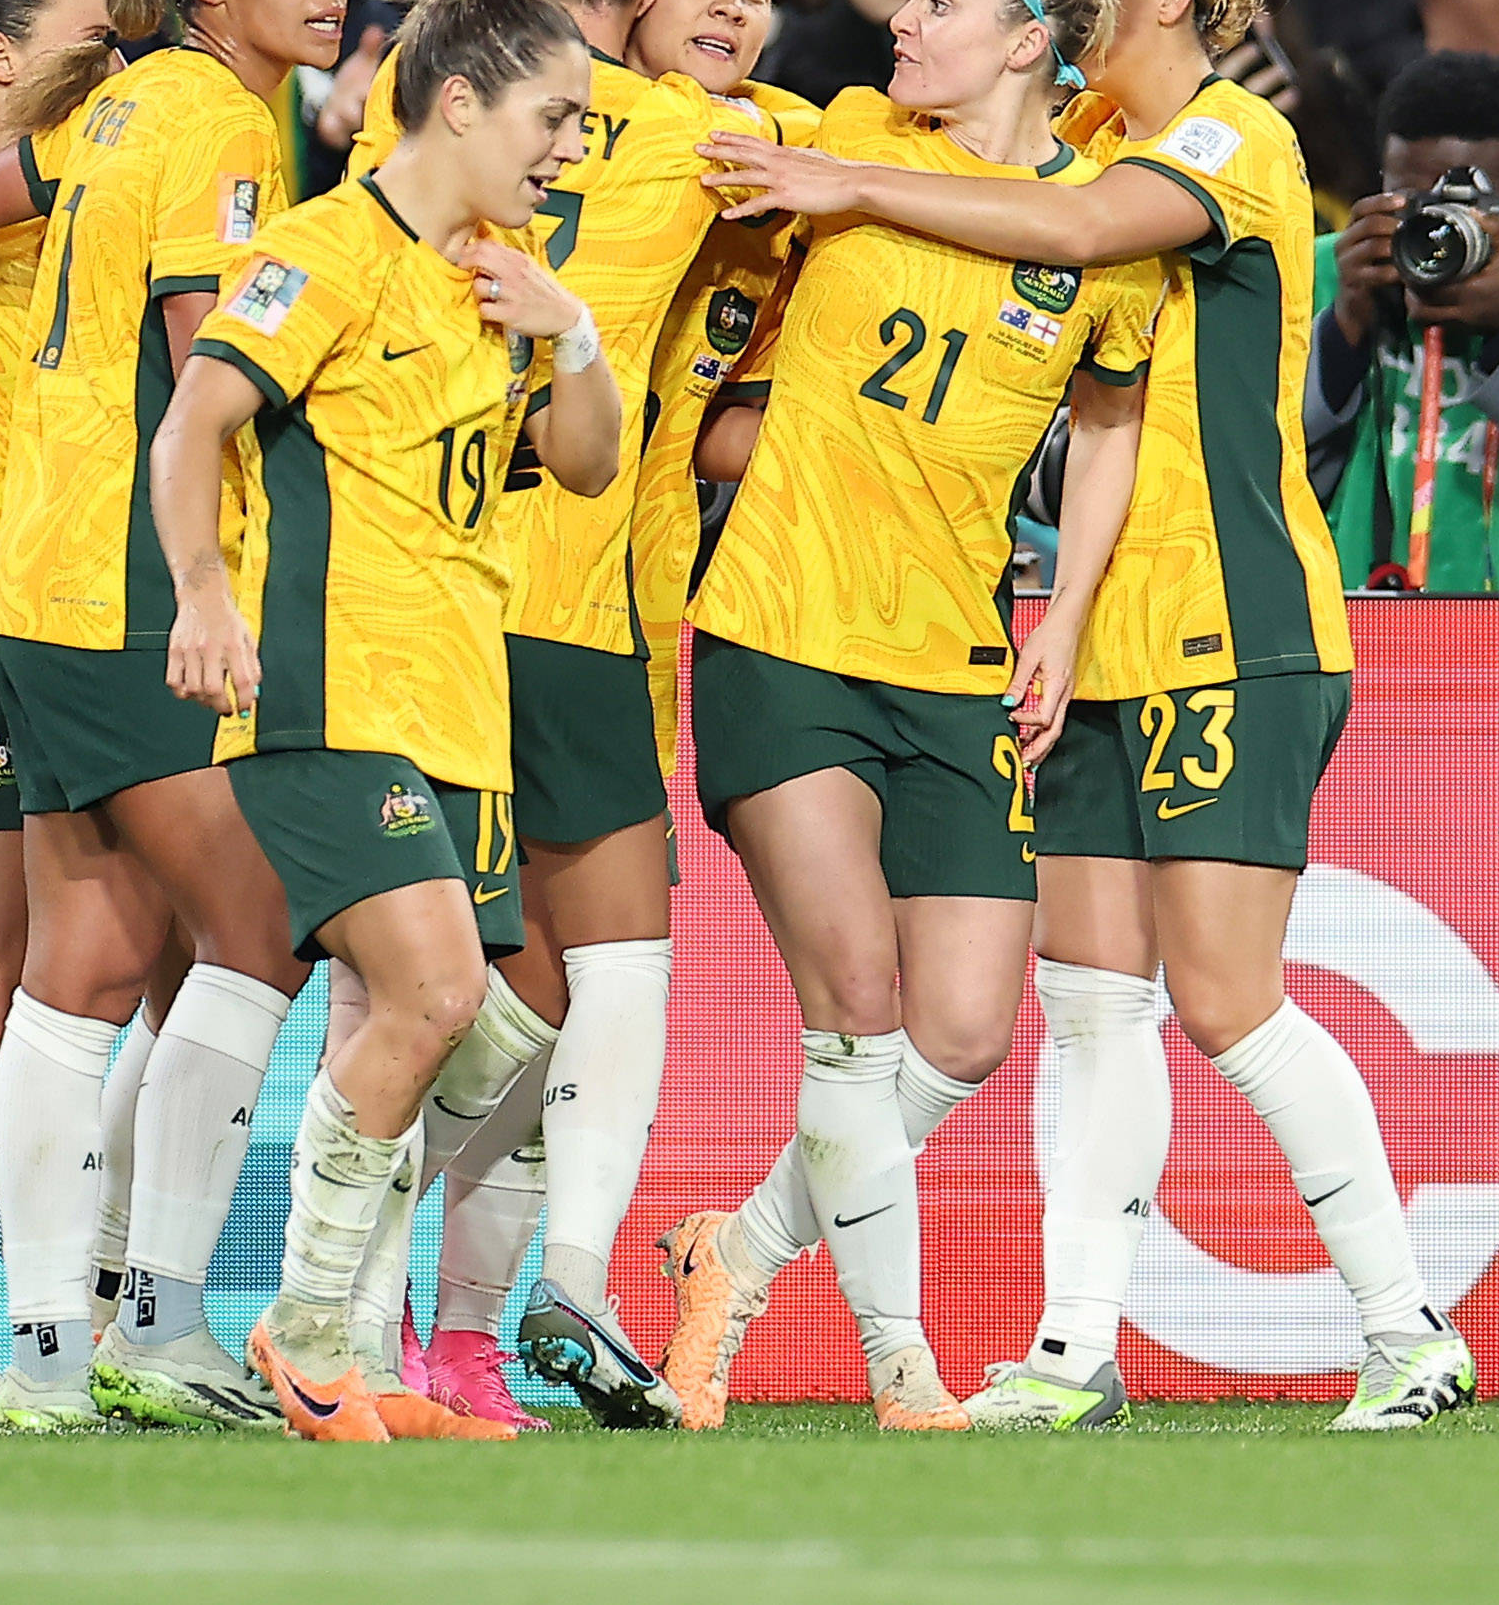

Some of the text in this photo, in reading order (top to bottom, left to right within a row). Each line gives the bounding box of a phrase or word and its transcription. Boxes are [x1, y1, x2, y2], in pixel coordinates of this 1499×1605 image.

[858, 306, 969, 426] 21
[435, 426, 486, 529] 19
[1139, 689, 1237, 793] 23
